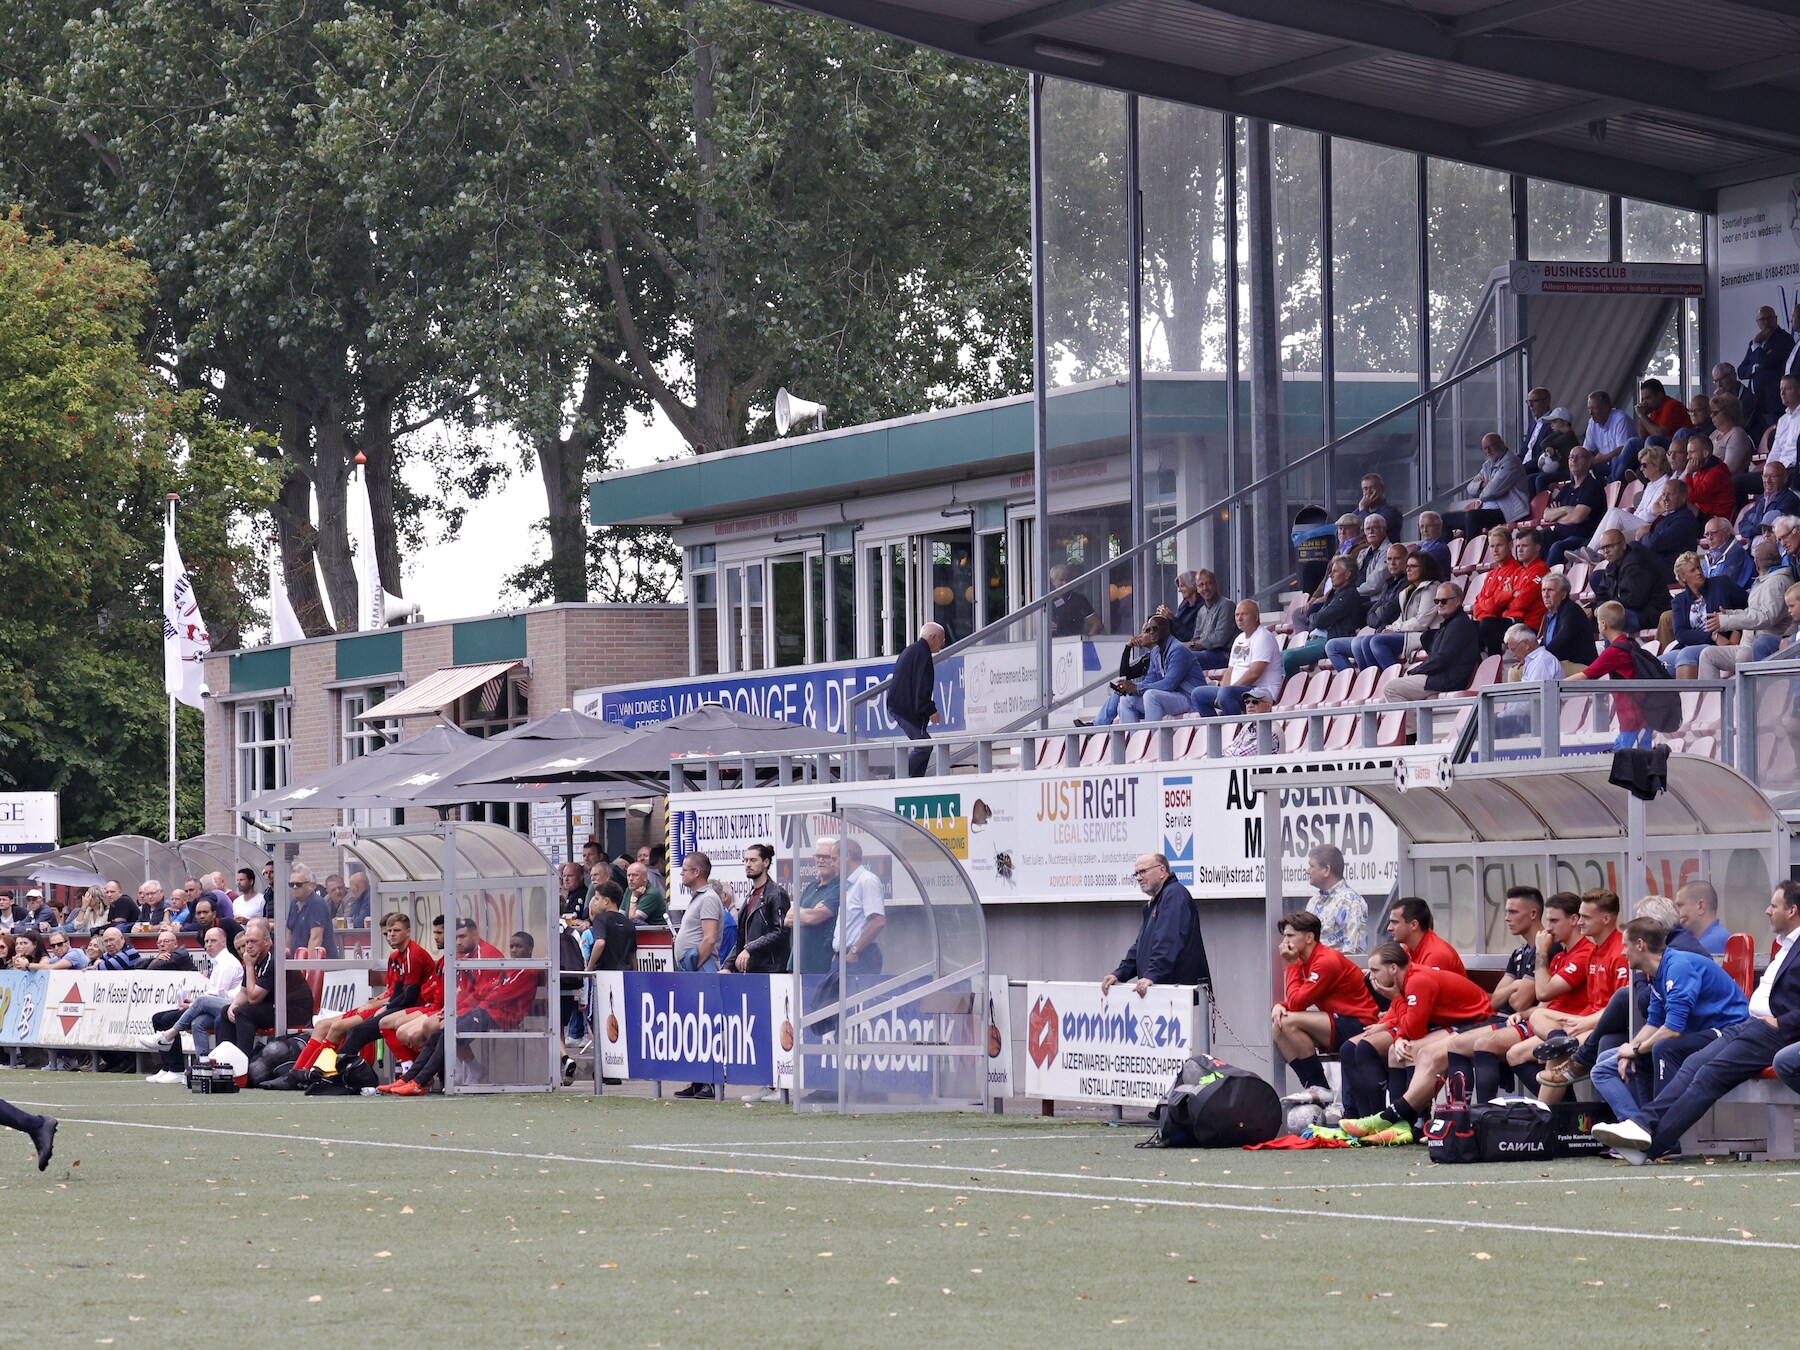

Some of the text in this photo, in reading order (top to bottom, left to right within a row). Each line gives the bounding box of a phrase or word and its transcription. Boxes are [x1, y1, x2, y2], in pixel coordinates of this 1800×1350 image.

[1721, 215, 1743, 231] Sportief
[1721, 223, 1782, 244] voor en na de wedstrijd
[1544, 265, 1627, 278] BUSINESSCLUB
[1721, 272, 1755, 287] Barendrecht
[1566, 284, 1610, 293] toegankelijk
[619, 698, 668, 717] VAN DONGE &
[803, 680, 817, 730] &
[1164, 789, 1192, 808] BOSCH
[899, 802, 956, 830] TRAAS
[1165, 812, 1192, 828] Service
[698, 815, 729, 841] ELECTRO
[730, 813, 757, 839] SUPPLY
[758, 813, 773, 838] B.V.
[1053, 821, 1128, 844] LEGAL SERVICES
[1244, 812, 1374, 859] MASSTAD
[1200, 865, 1254, 888] Stolwijkstraat
[1345, 863, 1359, 881] Tel.
[1361, 861, 1371, 880] 010
[92, 982, 106, 1004] Van
[107, 981, 129, 1004] Kessel
[130, 981, 154, 1008] Sport
[154, 987, 165, 1004] en
[641, 990, 757, 1066] Rabobank
[1062, 1001, 1139, 1047] annink
[604, 1052, 625, 1066] Rabobank
[1499, 1141, 1545, 1152] CAWILA
[1557, 1134, 1573, 1142] Fysio
